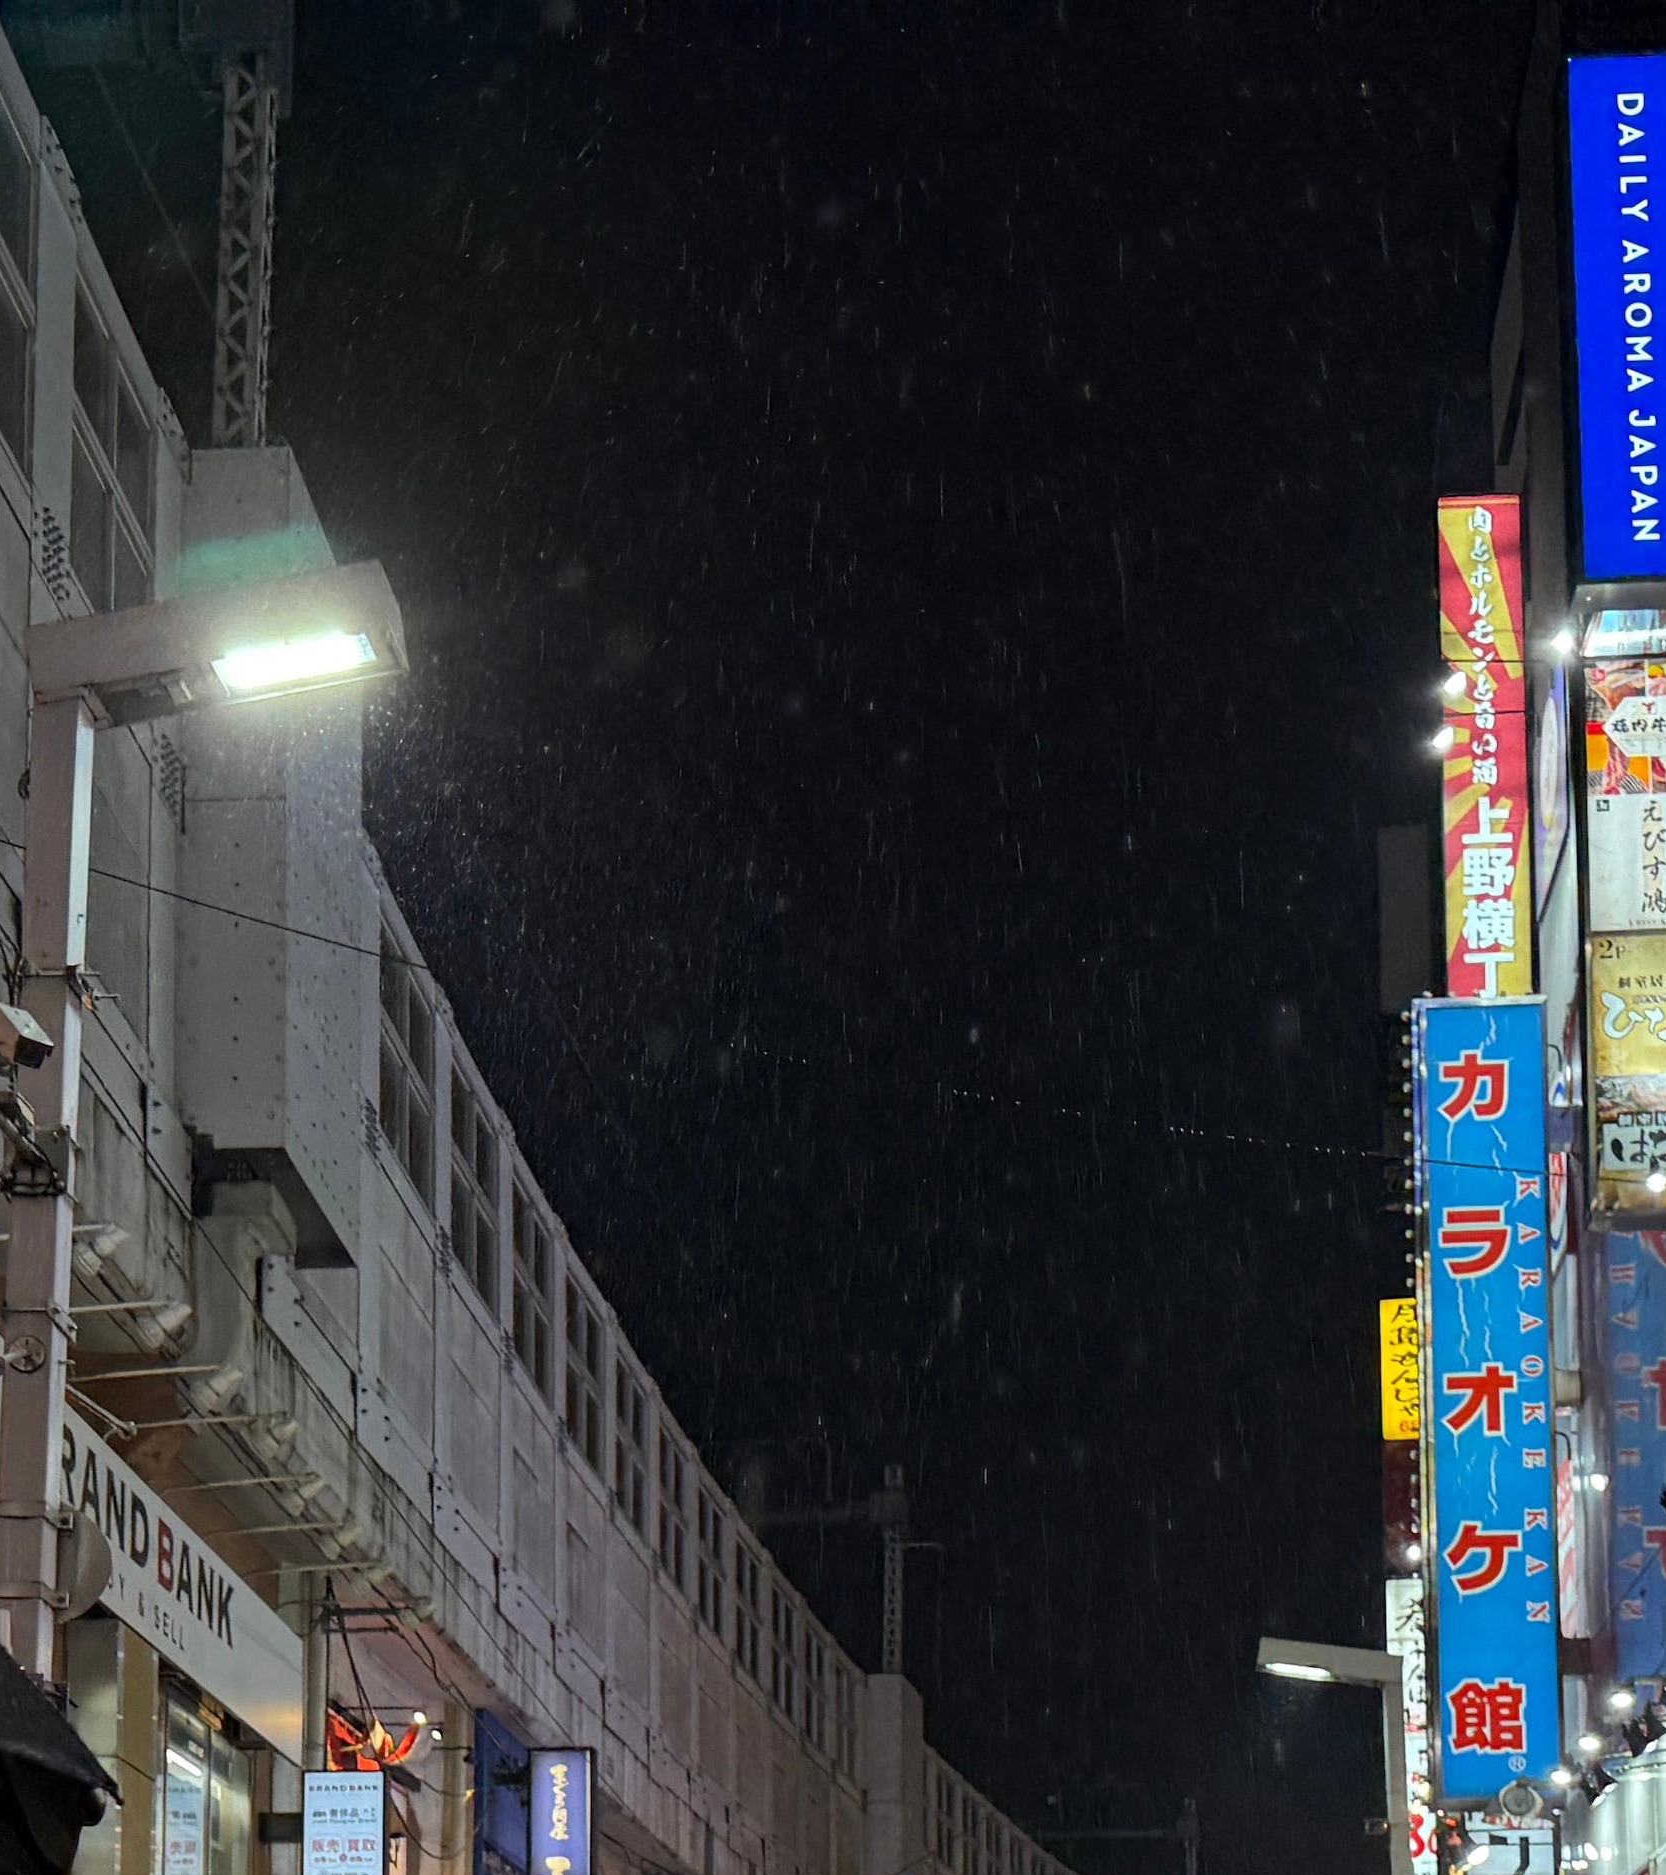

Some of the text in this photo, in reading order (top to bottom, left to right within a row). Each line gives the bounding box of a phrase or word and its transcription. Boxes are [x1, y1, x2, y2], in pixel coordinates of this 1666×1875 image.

[1617, 92, 1661, 543] DAILY AROMA JAPAN
[1460, 795, 1516, 999] 上野横丁
[1436, 1051, 1528, 1757] カラオケ館
[1516, 1175, 1551, 1624] KARAOKE KAN
[61, 1422, 234, 1651] RANDBANK
[154, 1603, 187, 1652] SELL
[311, 1839, 340, 1854] 販売
[347, 1838, 377, 1854] 買取
